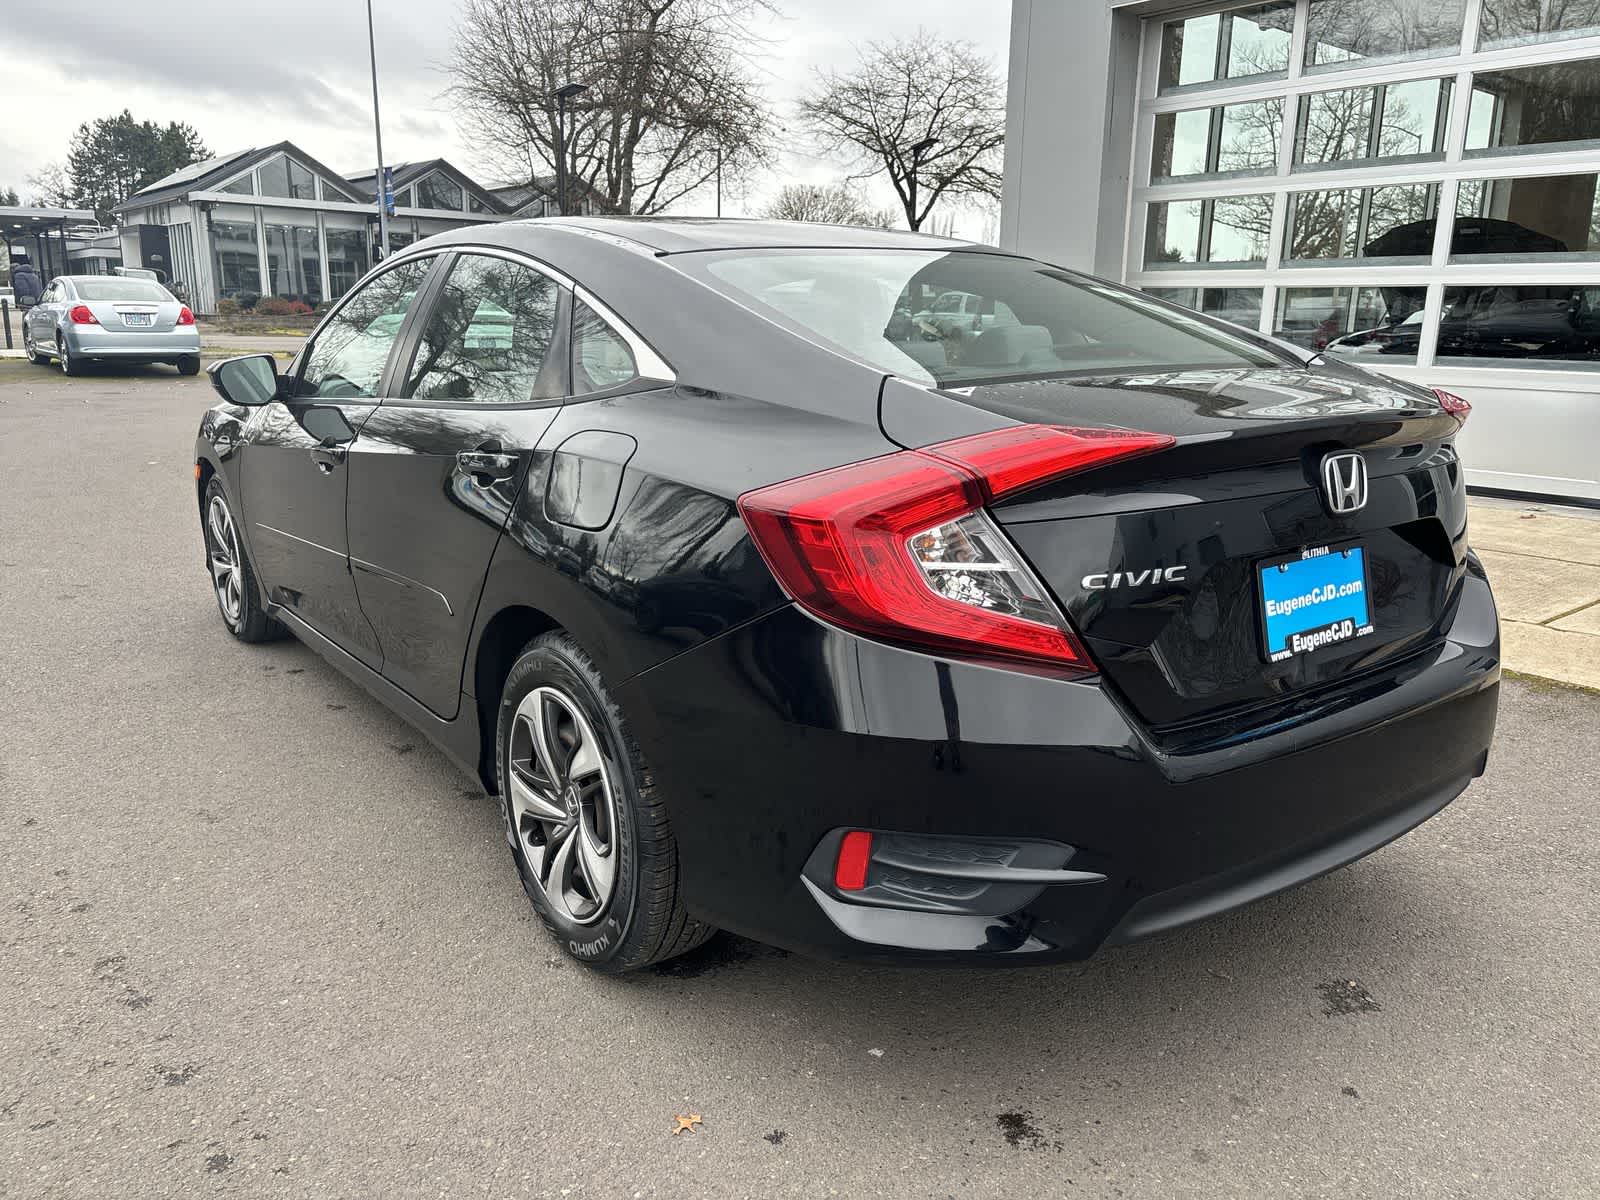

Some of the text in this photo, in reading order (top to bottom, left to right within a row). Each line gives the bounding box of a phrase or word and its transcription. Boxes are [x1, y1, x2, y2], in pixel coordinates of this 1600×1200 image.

[1307, 545, 1329, 558] LITHIA
[1081, 565, 1187, 589] CIVIC
[1265, 580, 1362, 617] EugeneCJD.com
[1292, 620, 1353, 652] EugeneCJD
[569, 933, 610, 958] KUMHO
